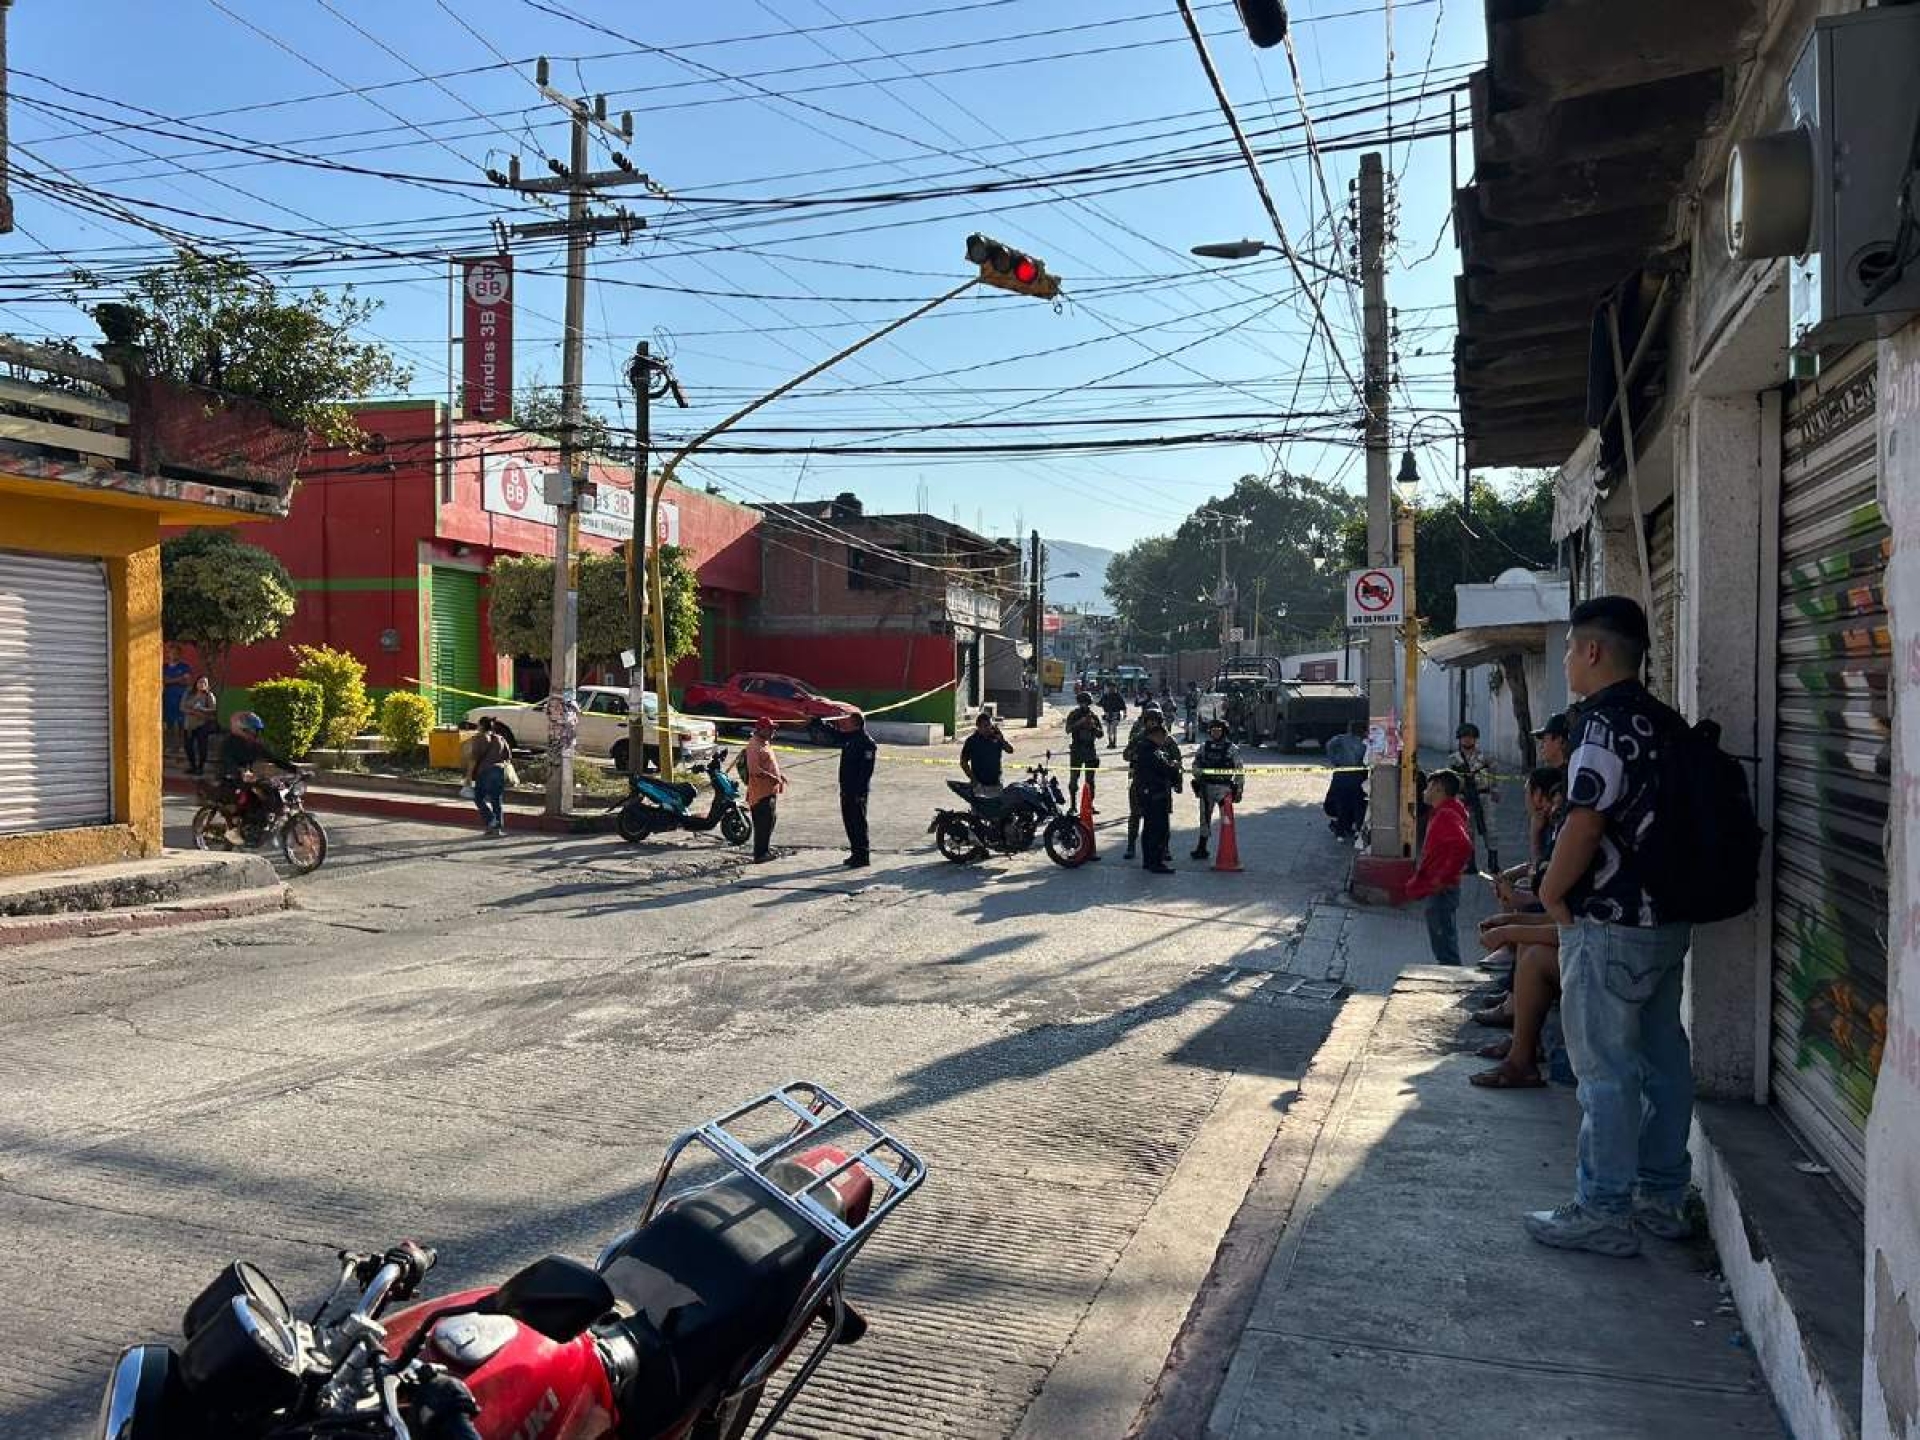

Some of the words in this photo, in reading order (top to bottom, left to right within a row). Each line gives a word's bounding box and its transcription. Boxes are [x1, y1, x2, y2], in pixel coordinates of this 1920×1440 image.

[480, 311, 496, 337] 3B
[480, 341, 496, 412] Tiendas
[506, 484, 524, 503] BB
